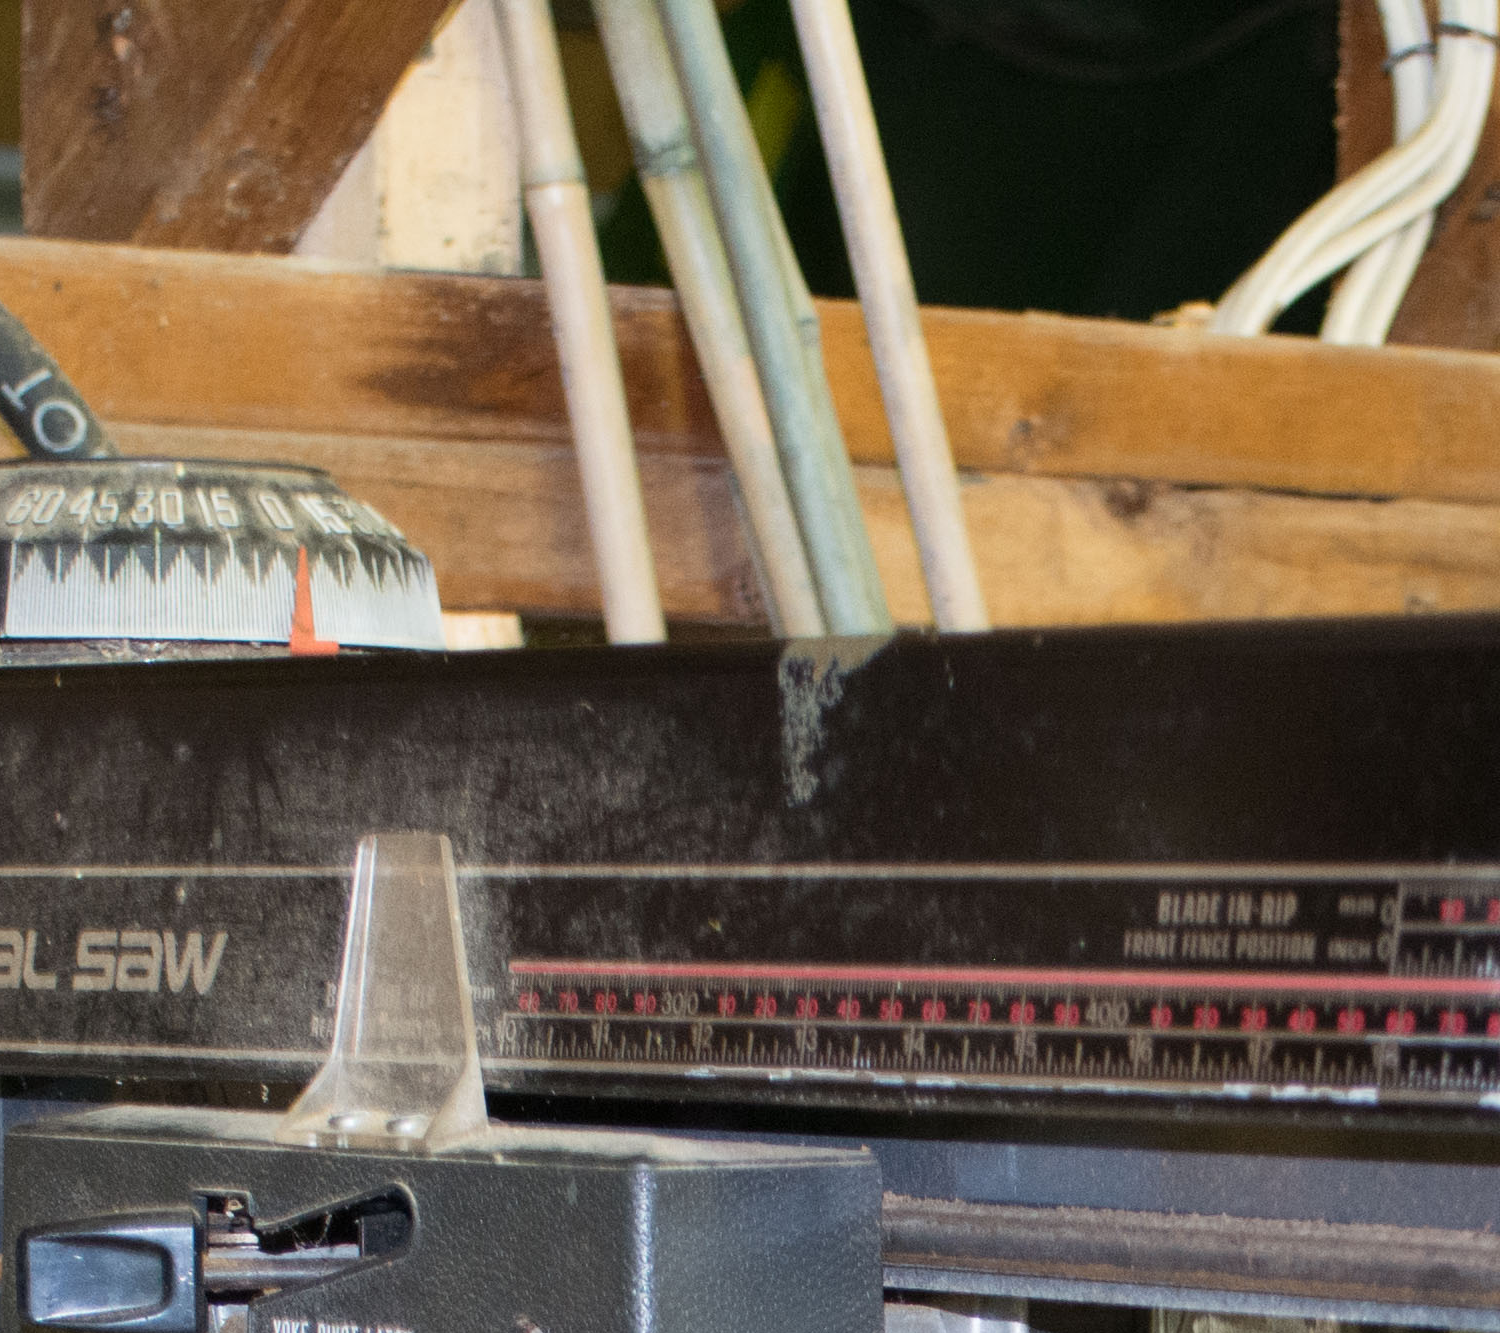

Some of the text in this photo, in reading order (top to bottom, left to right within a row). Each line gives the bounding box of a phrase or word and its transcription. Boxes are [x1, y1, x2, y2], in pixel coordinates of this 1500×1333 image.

[1, 368, 90, 454] OT
[69, 487, 124, 525] 45
[131, 487, 185, 527] 30
[197, 488, 240, 530] 15
[1158, 889, 1221, 925] BLADE
[1123, 930, 1177, 958] FRONT
[1182, 931, 1230, 959] FENCE
[1235, 932, 1317, 961] POSITION
